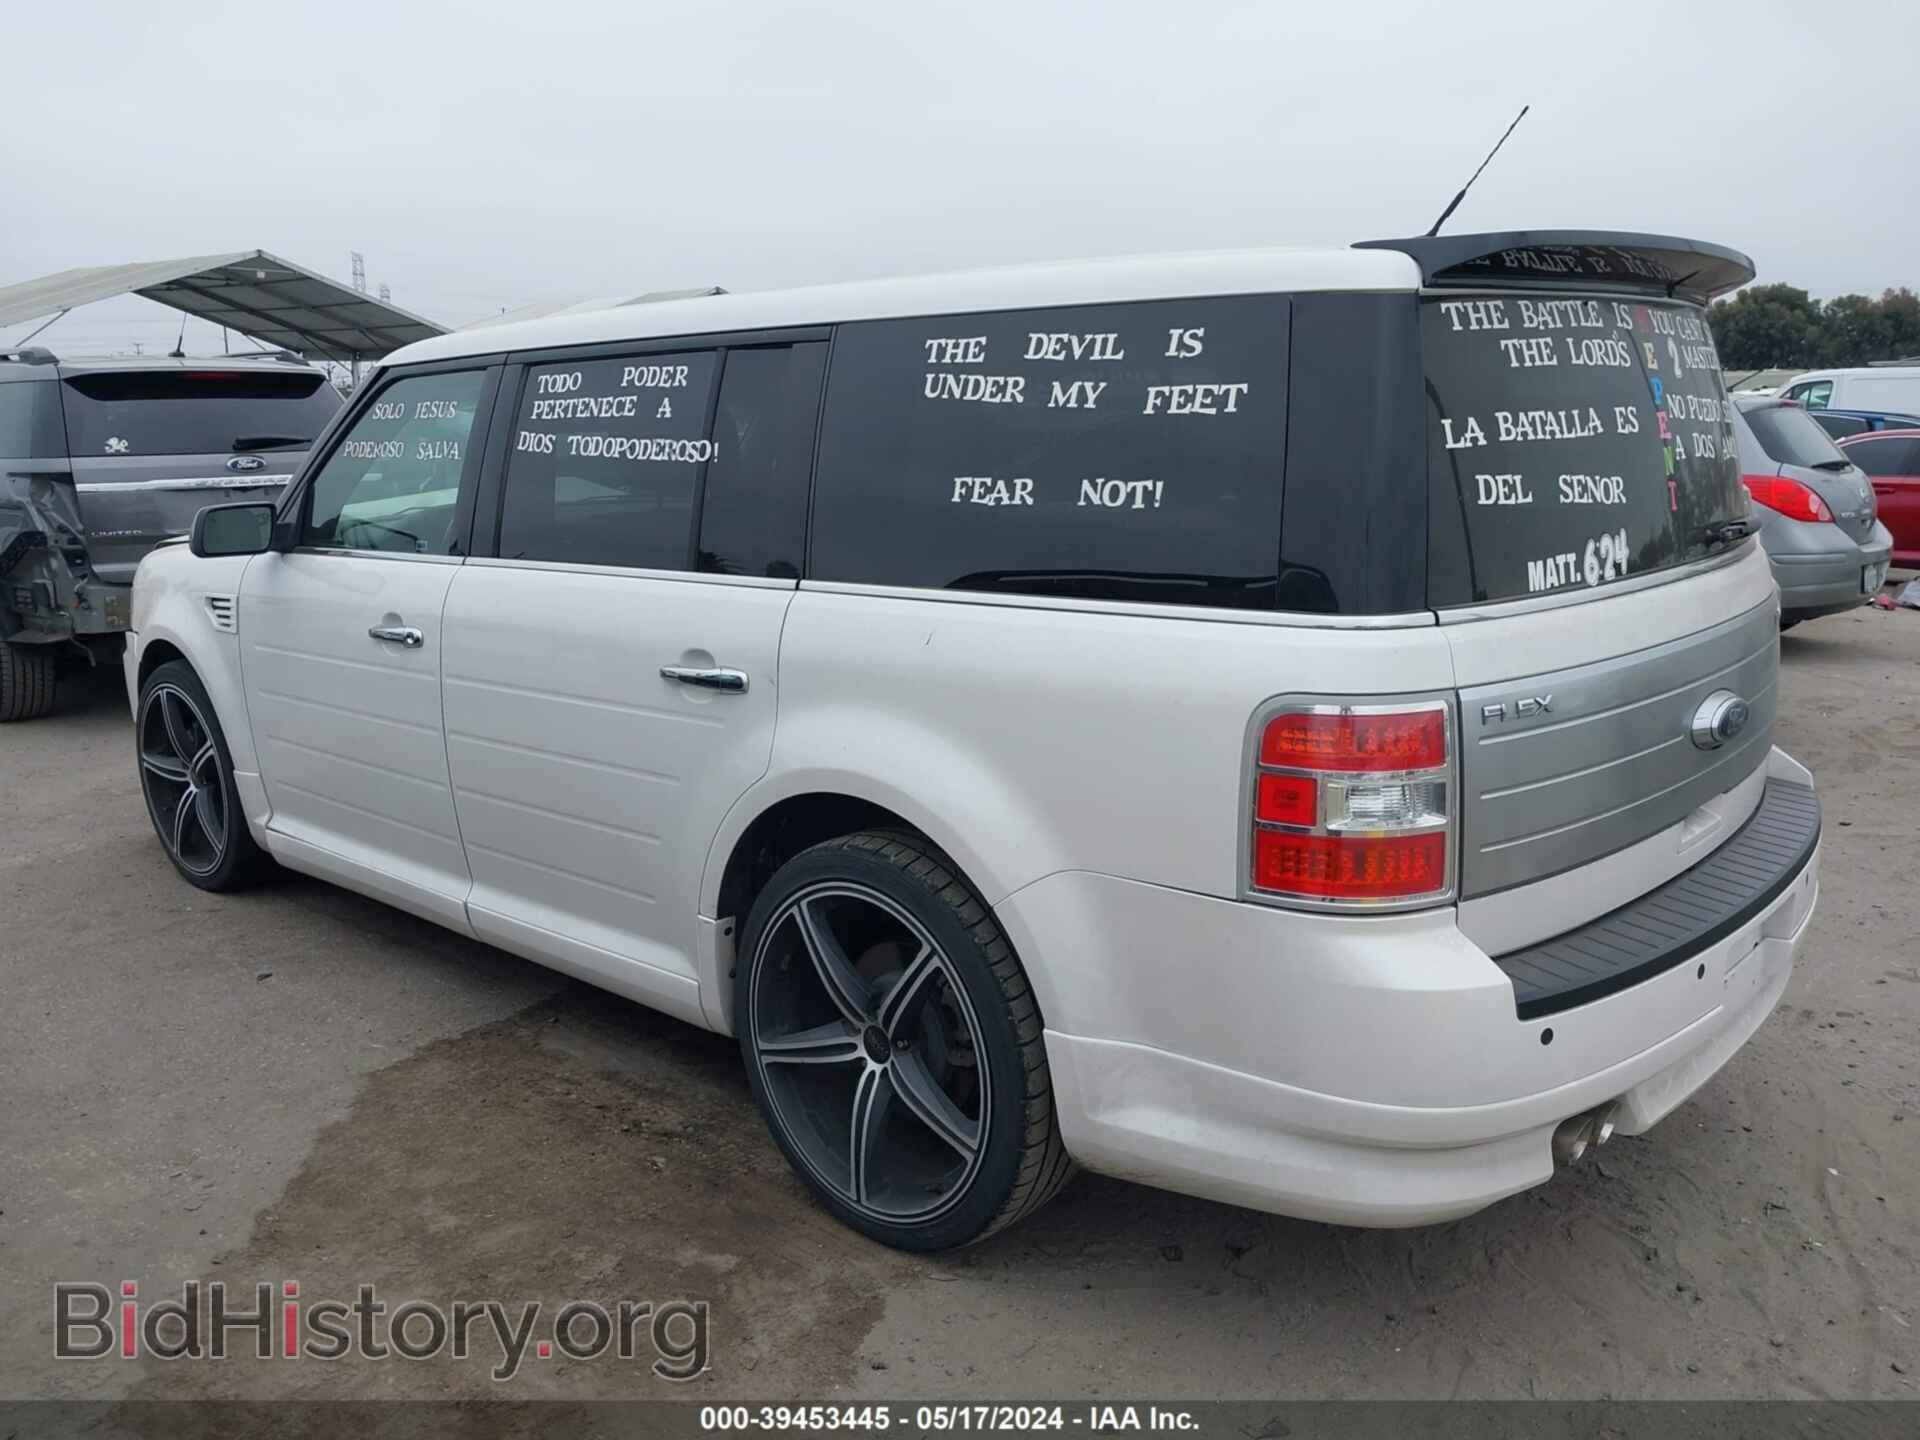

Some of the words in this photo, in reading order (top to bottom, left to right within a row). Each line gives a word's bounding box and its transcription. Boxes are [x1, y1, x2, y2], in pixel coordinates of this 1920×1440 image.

[1440, 301, 1510, 331] THE
[1519, 300, 1604, 329] BATTLE
[1611, 302, 1633, 330] IS
[1647, 308, 1675, 335] YOU
[924, 336, 987, 363] THE
[1024, 333, 1125, 361] DEVIL
[1165, 328, 1205, 358] IS
[1501, 337, 1558, 368] THE
[537, 372, 582, 394] TODO
[621, 365, 689, 388] PODER
[924, 373, 1026, 403] UNDER
[1047, 381, 1107, 409] MY
[1143, 383, 1249, 415] FEET
[372, 402, 405, 420] SOLO
[414, 400, 458, 419] JESUS
[530, 396, 638, 419] PERTENECE
[656, 398, 672, 419] A
[1666, 394, 1686, 419] NO
[1441, 416, 1487, 449] LA
[1494, 407, 1604, 442] BATALLA
[1614, 406, 1640, 434] ES
[343, 441, 405, 459] PODEROSO
[517, 430, 556, 454] DIOS
[567, 435, 720, 463] TODOPODEROSO!
[1675, 434, 1687, 460] A
[1691, 432, 1716, 459] DOS
[952, 477, 1034, 506] FEAR
[1077, 478, 1164, 509] NOT!
[1475, 474, 1533, 505] DEL
[1559, 475, 1627, 505] SENOR
[1527, 552, 1581, 592] MATT.
